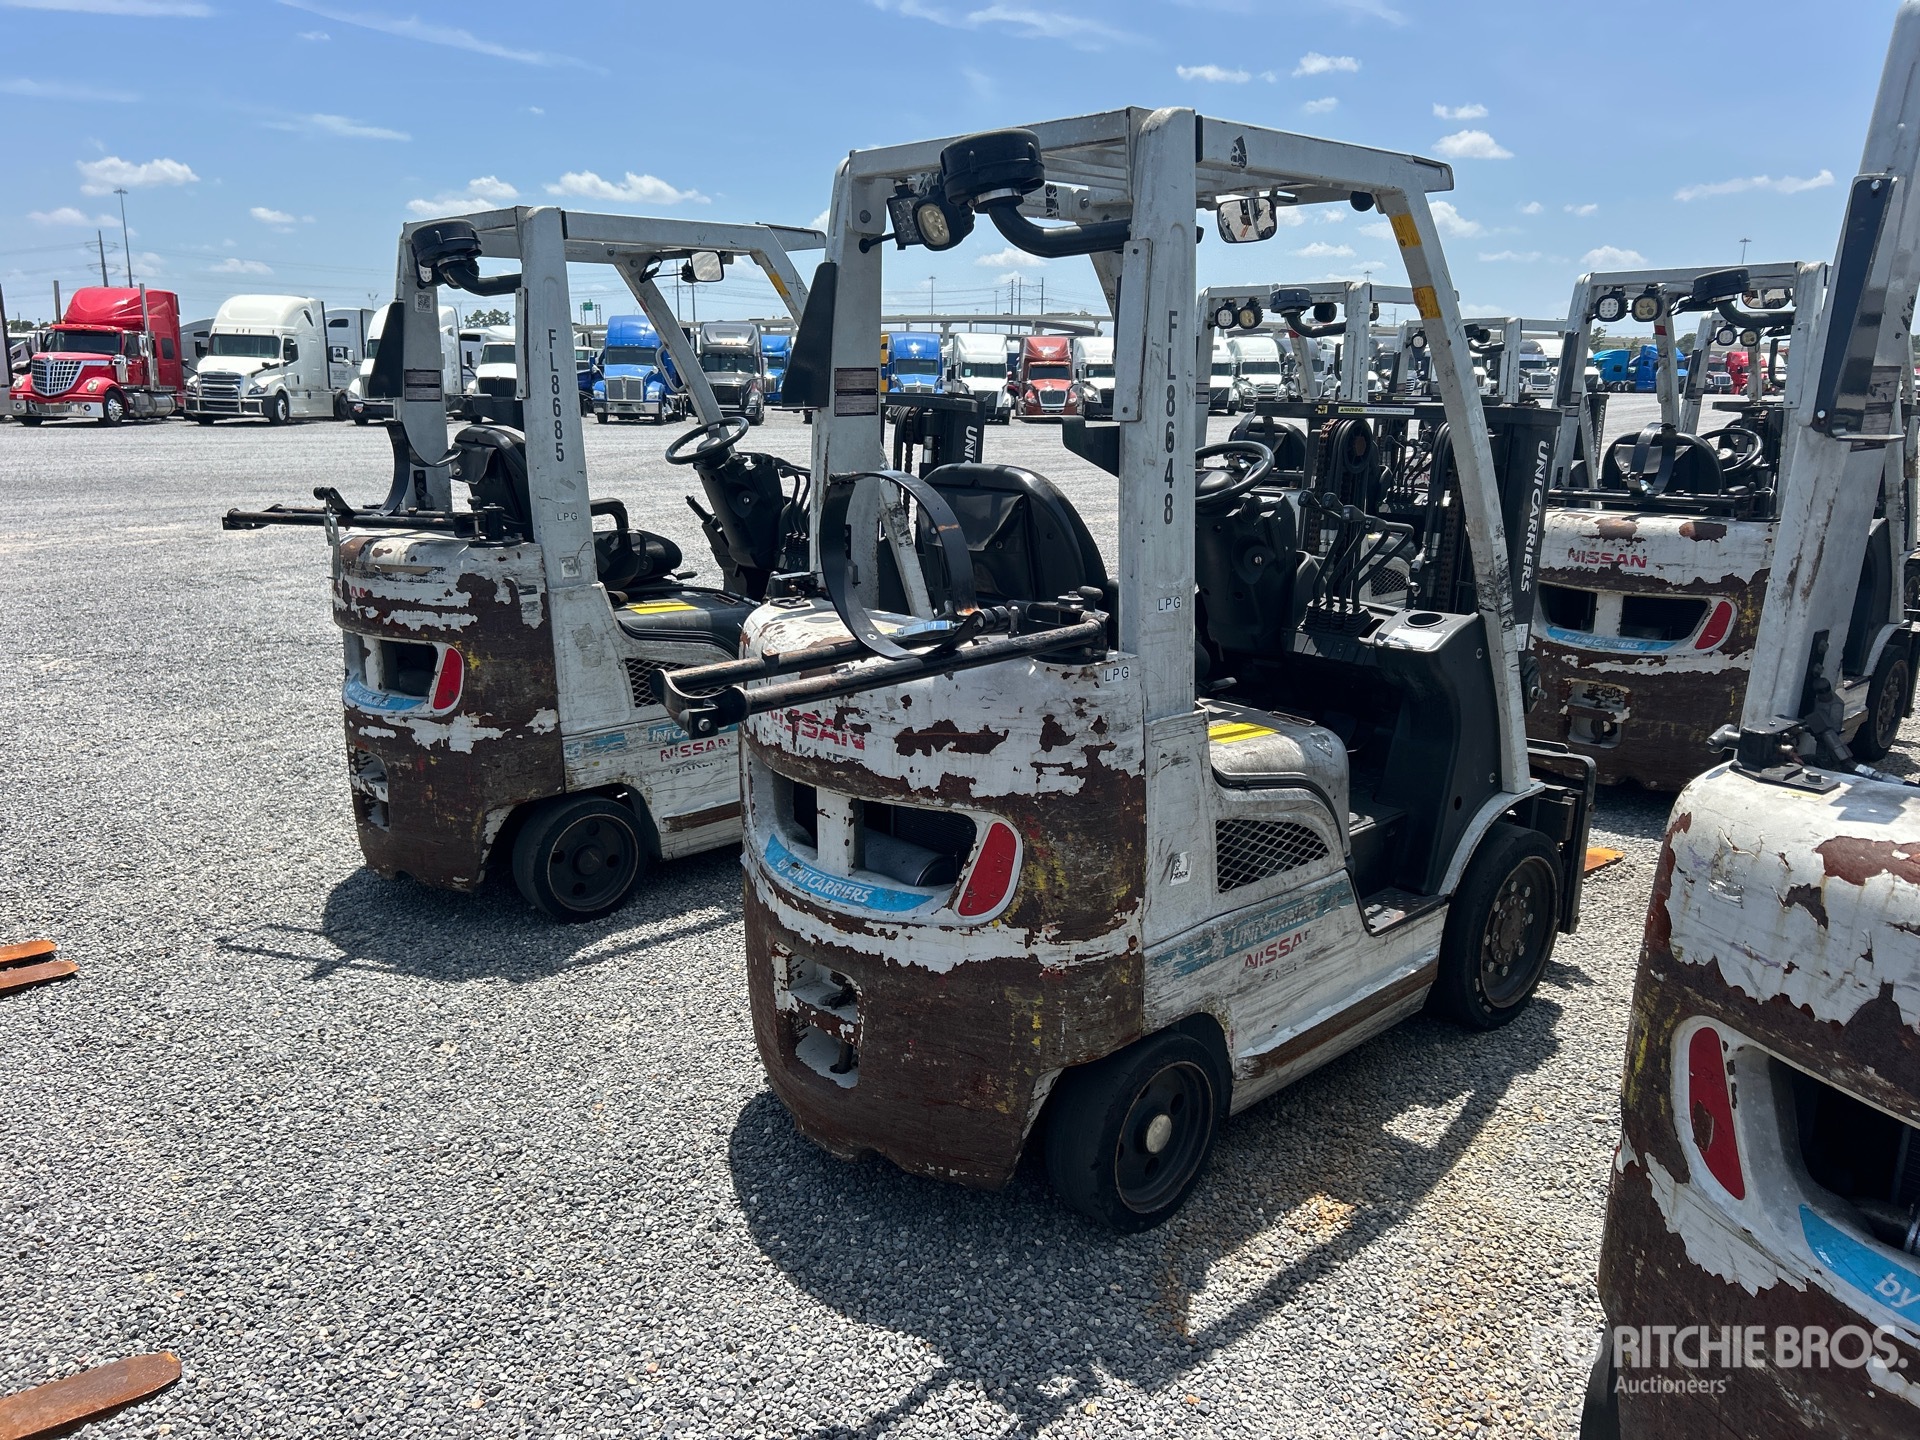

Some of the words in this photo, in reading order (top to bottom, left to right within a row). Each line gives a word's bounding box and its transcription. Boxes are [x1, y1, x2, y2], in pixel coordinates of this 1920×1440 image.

[548, 328, 565, 462] FL8685
[1163, 310, 1178, 525] FL8648
[556, 512, 578, 521] LPG
[1520, 440, 1549, 592] UNICARRIERS
[1567, 549, 1647, 568] NISSAN
[1158, 596, 1181, 611] LPG
[1104, 666, 1129, 682] LPG
[777, 857, 790, 872] by
[788, 864, 874, 902] UNICARRIERS
[1874, 1272, 1920, 1308] by
